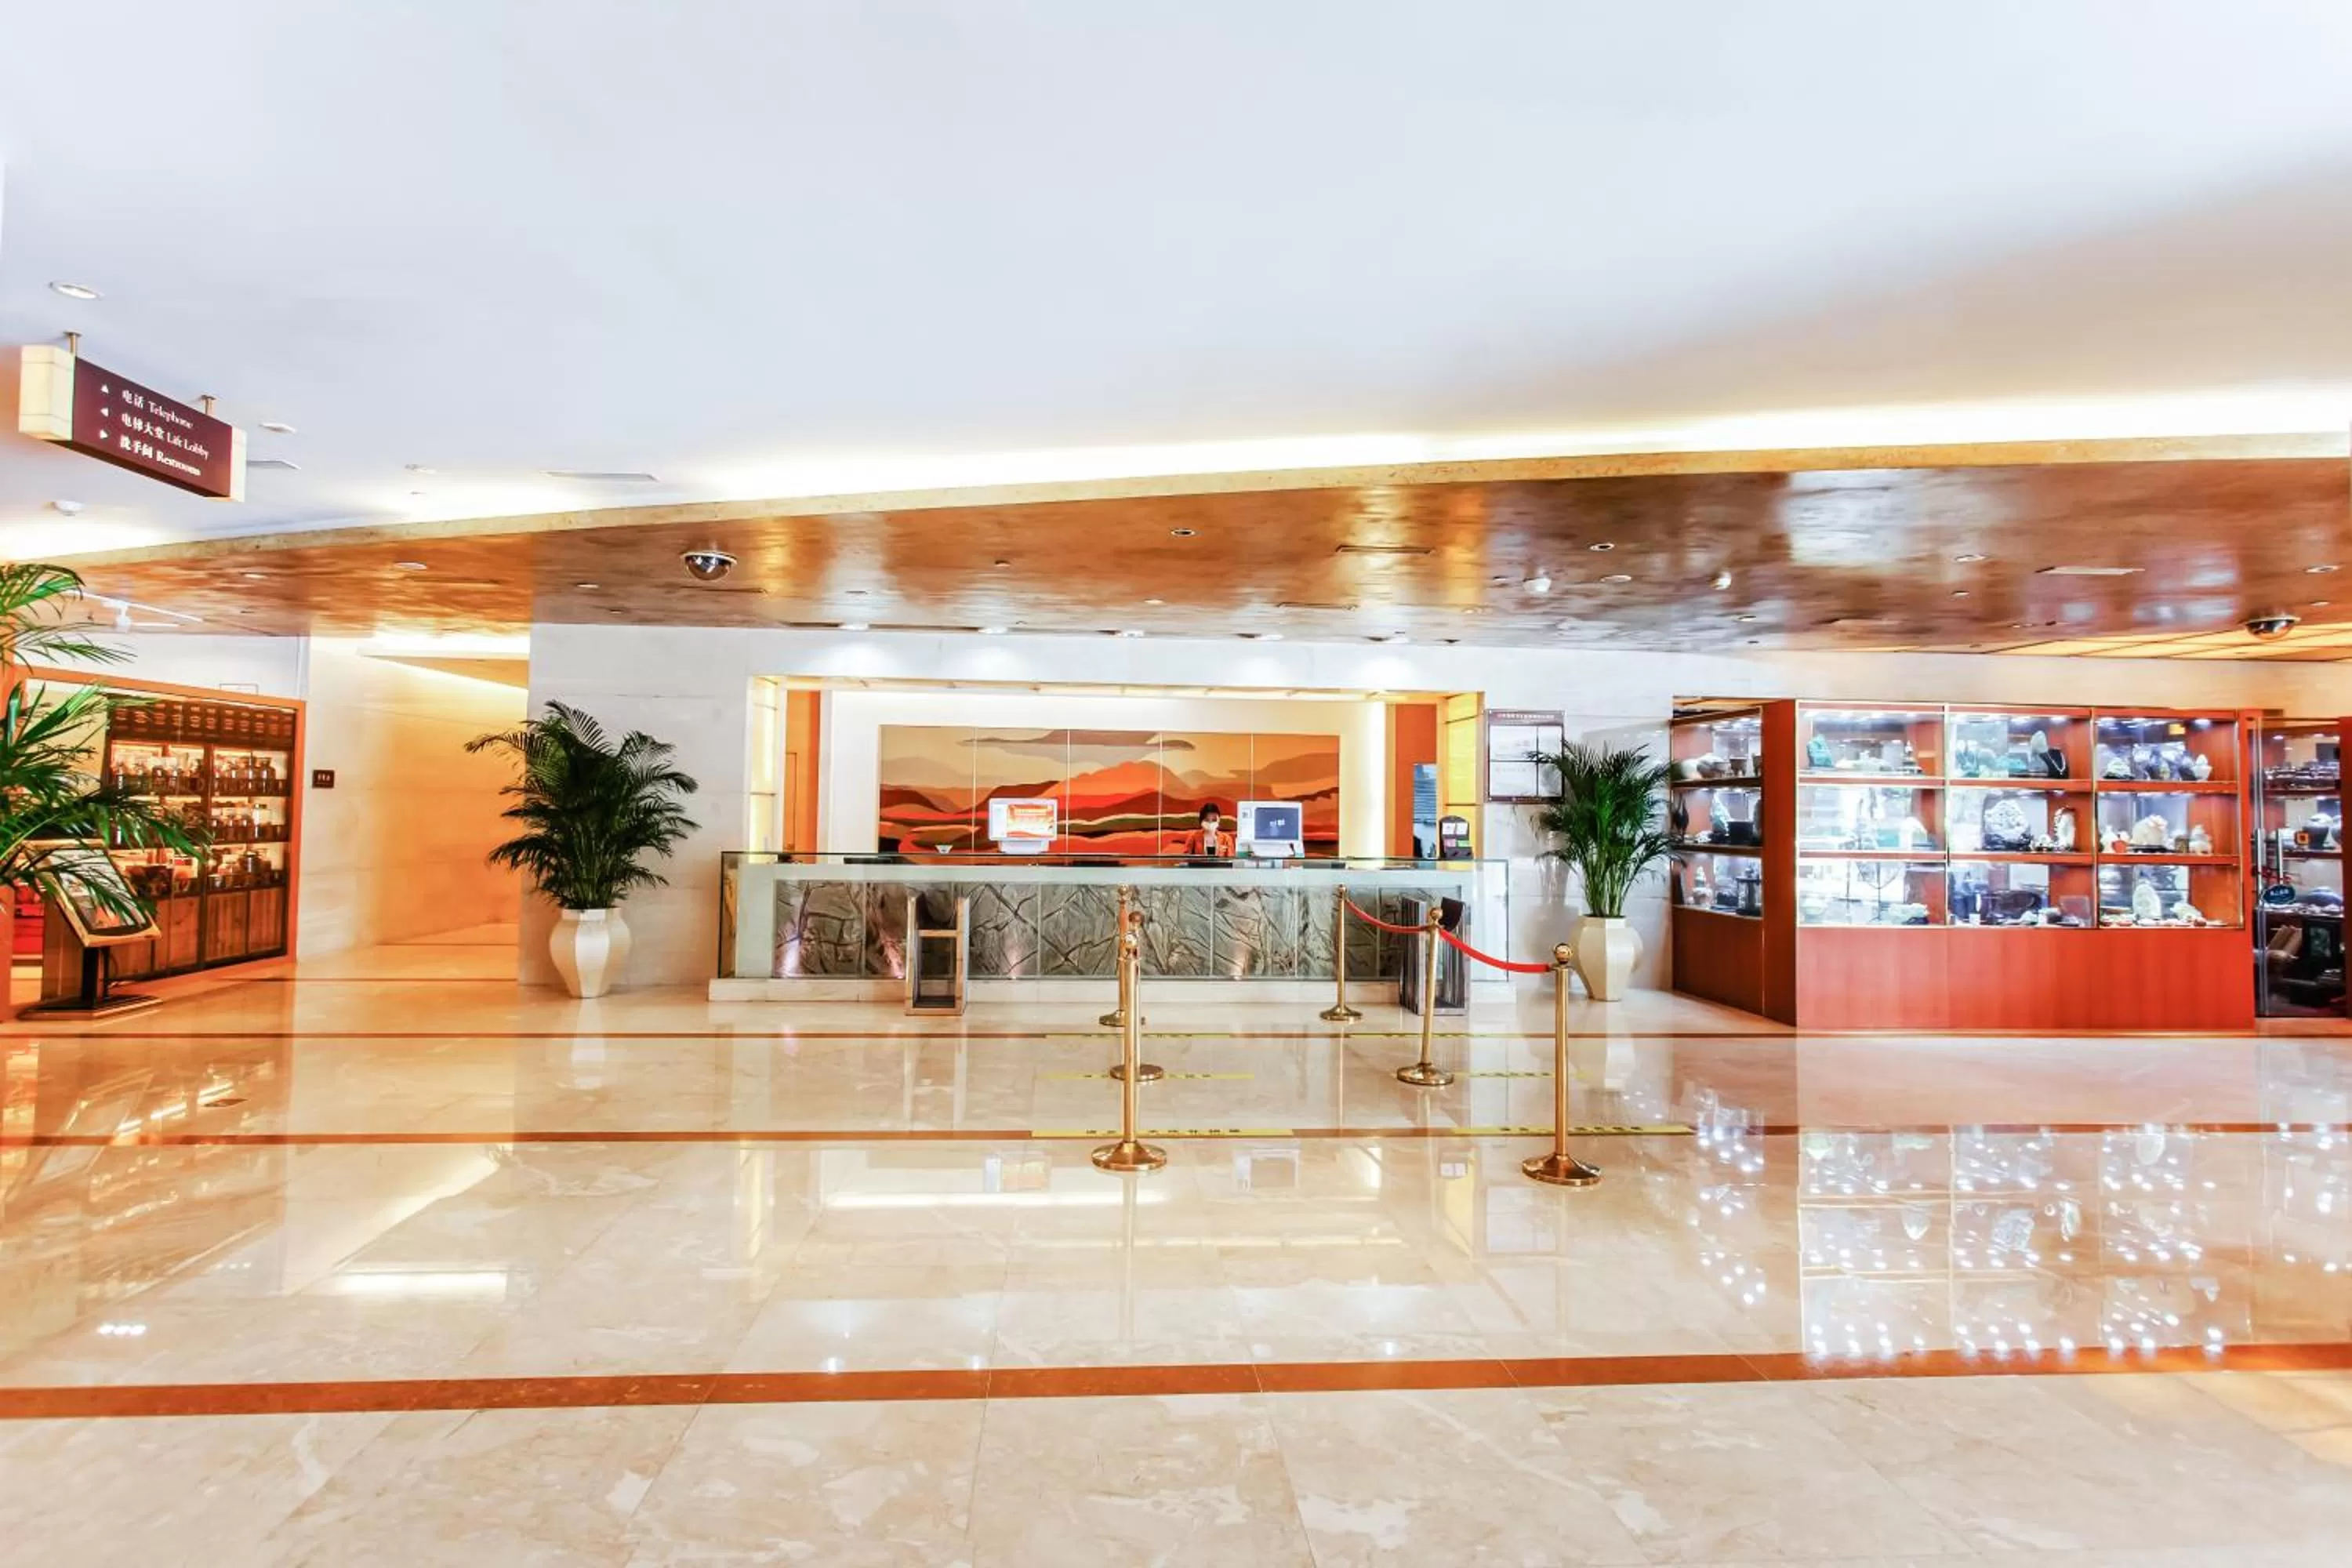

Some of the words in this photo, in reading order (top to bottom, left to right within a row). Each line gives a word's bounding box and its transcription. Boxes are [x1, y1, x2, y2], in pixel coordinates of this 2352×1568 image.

[148, 401, 194, 428] Telephone
[167, 432, 183, 448] Lift
[183, 439, 209, 460] Lobby
